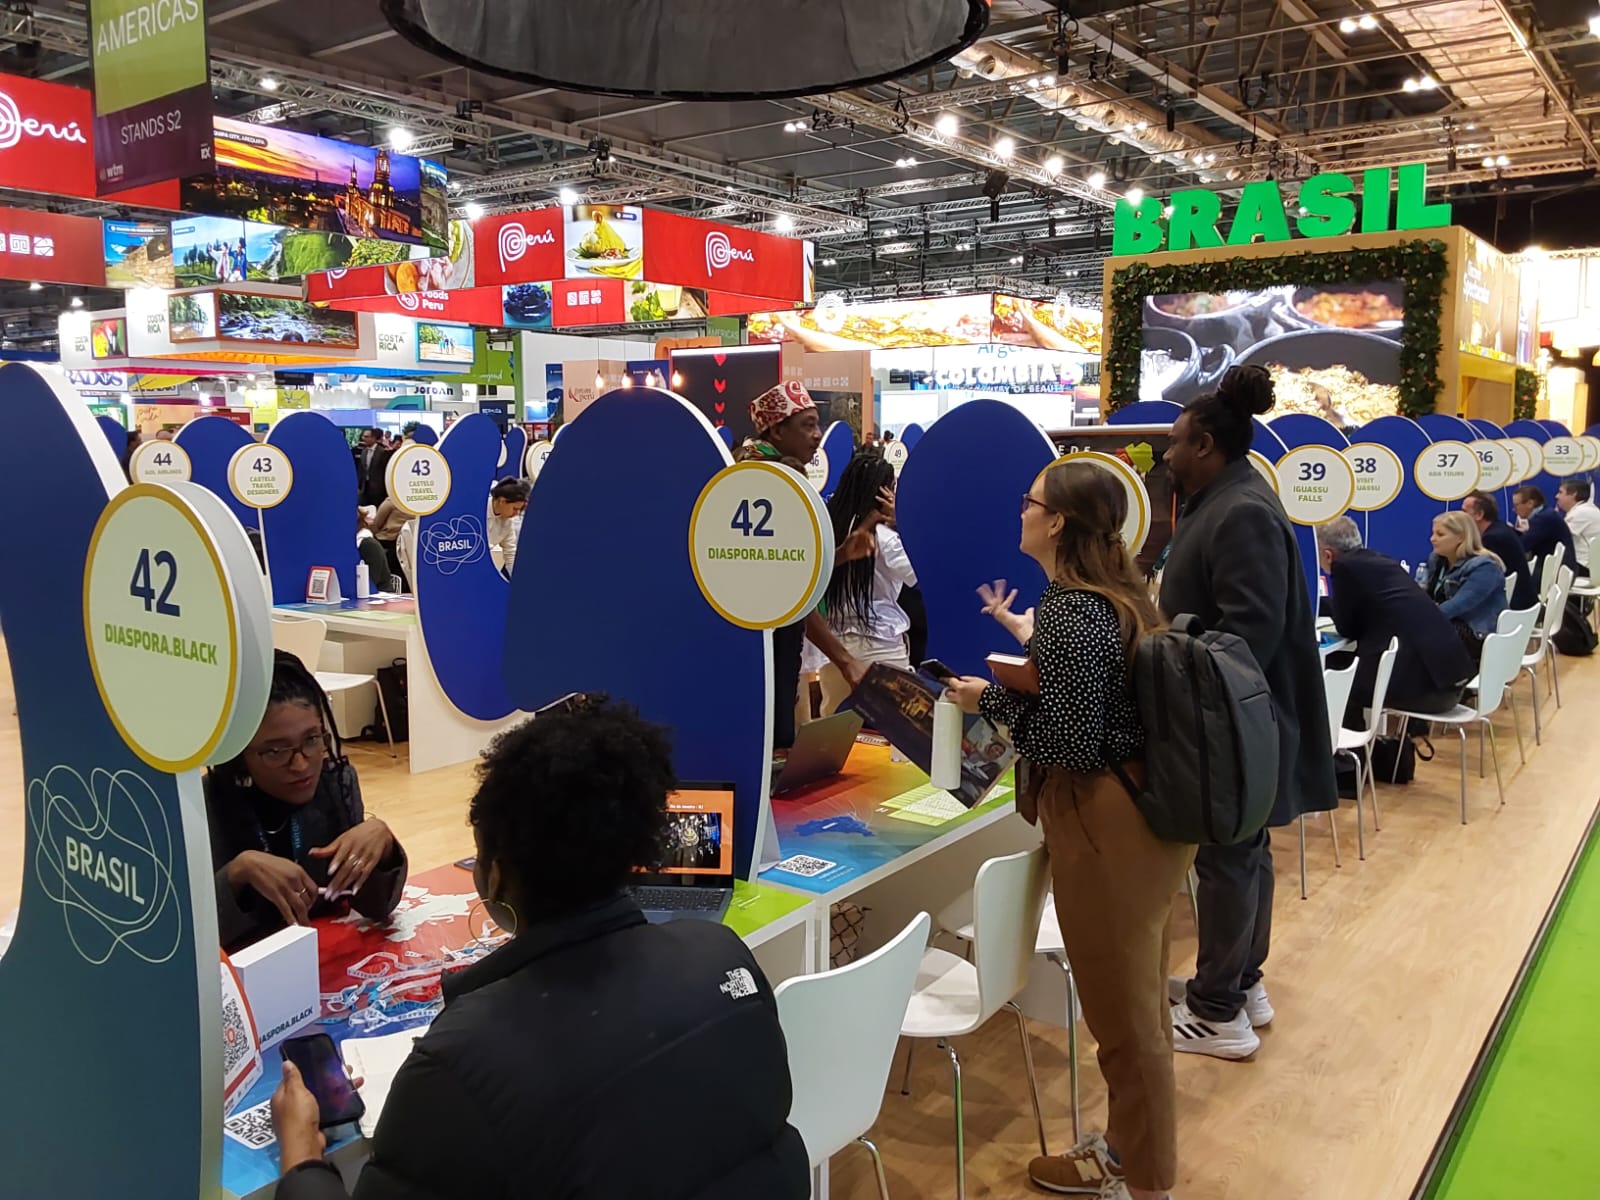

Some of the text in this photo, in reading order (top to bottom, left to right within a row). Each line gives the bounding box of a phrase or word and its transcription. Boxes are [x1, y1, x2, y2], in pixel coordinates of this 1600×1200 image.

[97, 0, 200, 56] AMERICAS
[121, 110, 182, 145] STANDS S2
[1112, 163, 1451, 256] BRASIL
[422, 298, 444, 311] Peru
[379, 333, 404, 343] COSTA
[379, 342, 398, 351] RICA
[1555, 445, 1569, 455] 33
[153, 453, 172, 466] 44
[252, 458, 272, 472] 43
[1354, 458, 1376, 473] 38
[1437, 454, 1459, 468] 37
[411, 460, 430, 476] 43
[1298, 462, 1326, 481] 39
[1293, 485, 1328, 493] IGUASSU
[406, 494, 438, 502] DESIGNERS
[1298, 494, 1322, 502] FALLS
[731, 499, 774, 537] 42
[438, 539, 472, 552] BRASIL
[708, 547, 805, 561] DIASPORA.BLACK
[130, 548, 180, 617] 42
[105, 623, 218, 665] DIASPORA.BLACK
[66, 836, 145, 905] BRASIL
[259, 1006, 313, 1045] IASPORA.BLACK
